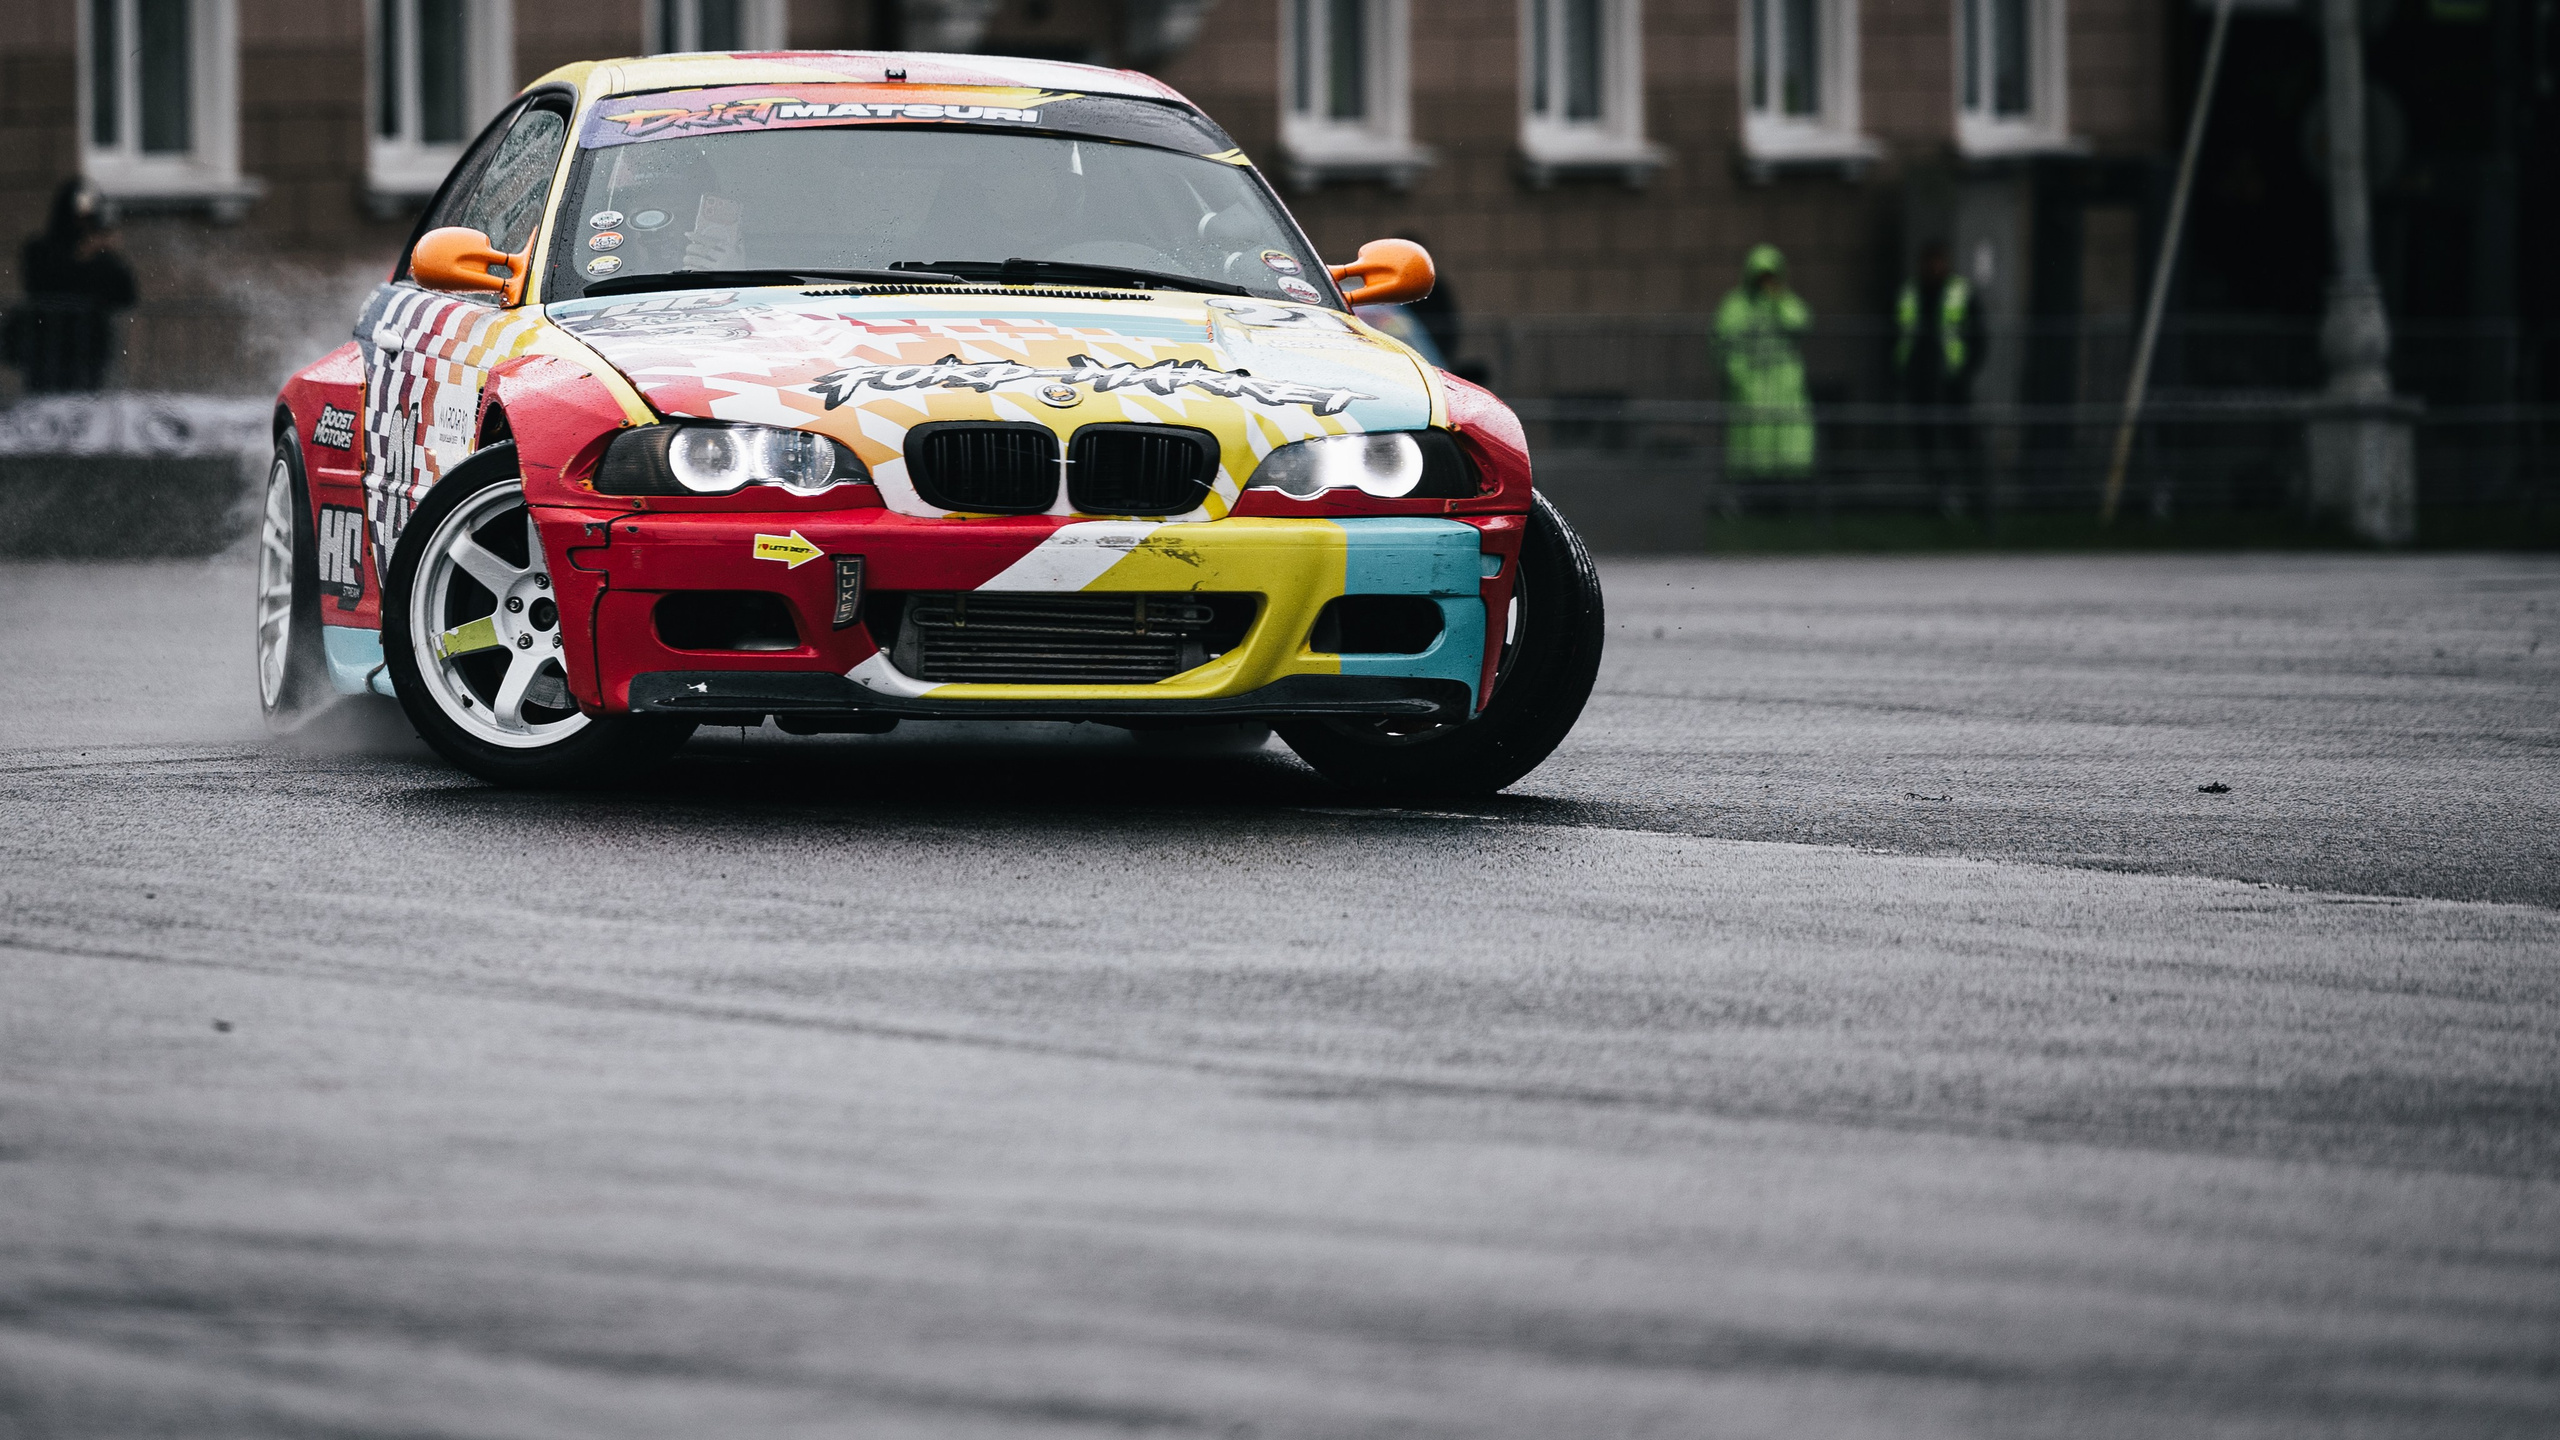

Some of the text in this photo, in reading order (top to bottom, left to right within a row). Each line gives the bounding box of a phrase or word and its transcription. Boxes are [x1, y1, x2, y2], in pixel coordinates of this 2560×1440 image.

[779, 103, 1038, 123] MATSURI
[321, 405, 355, 430] BOOST
[313, 422, 354, 449] MOTORS
